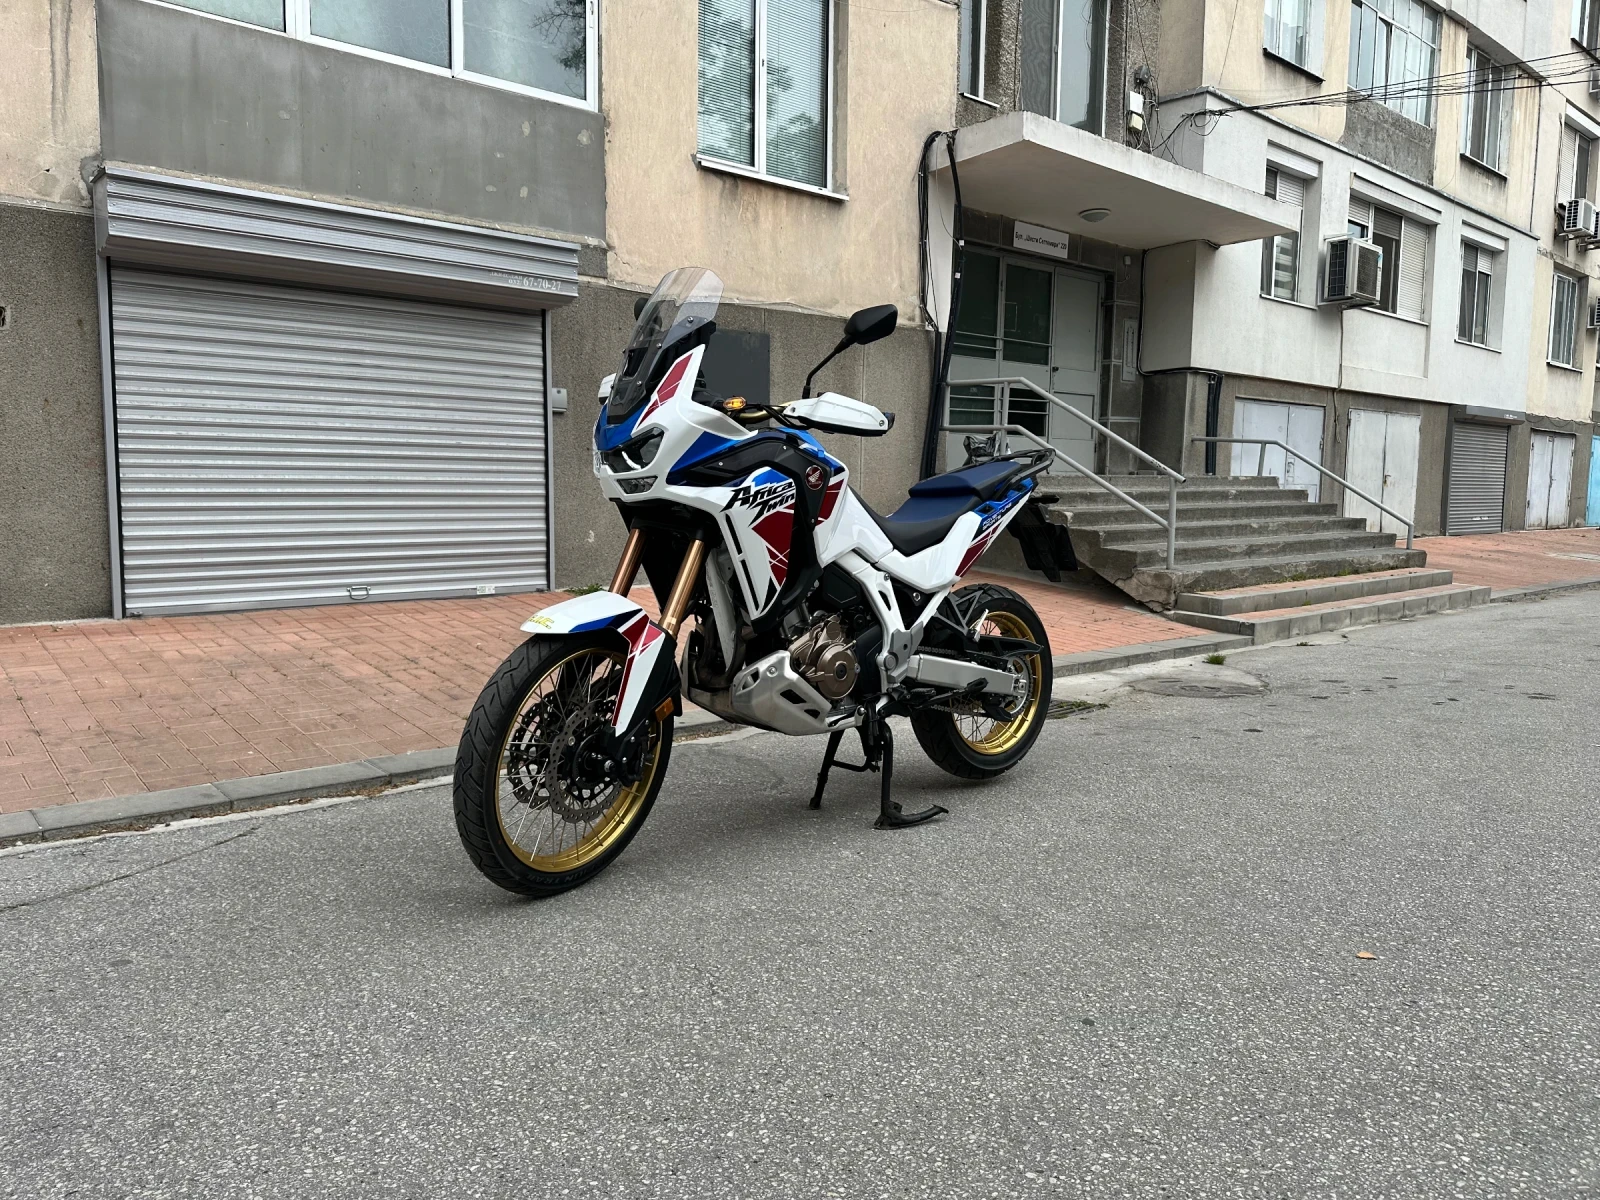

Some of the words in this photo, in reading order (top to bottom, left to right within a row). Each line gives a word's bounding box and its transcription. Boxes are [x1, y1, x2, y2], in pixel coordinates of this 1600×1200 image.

[523, 276, 562, 291] 67-70-27
[719, 482, 795, 513] Africa
[748, 489, 795, 527] Twin
